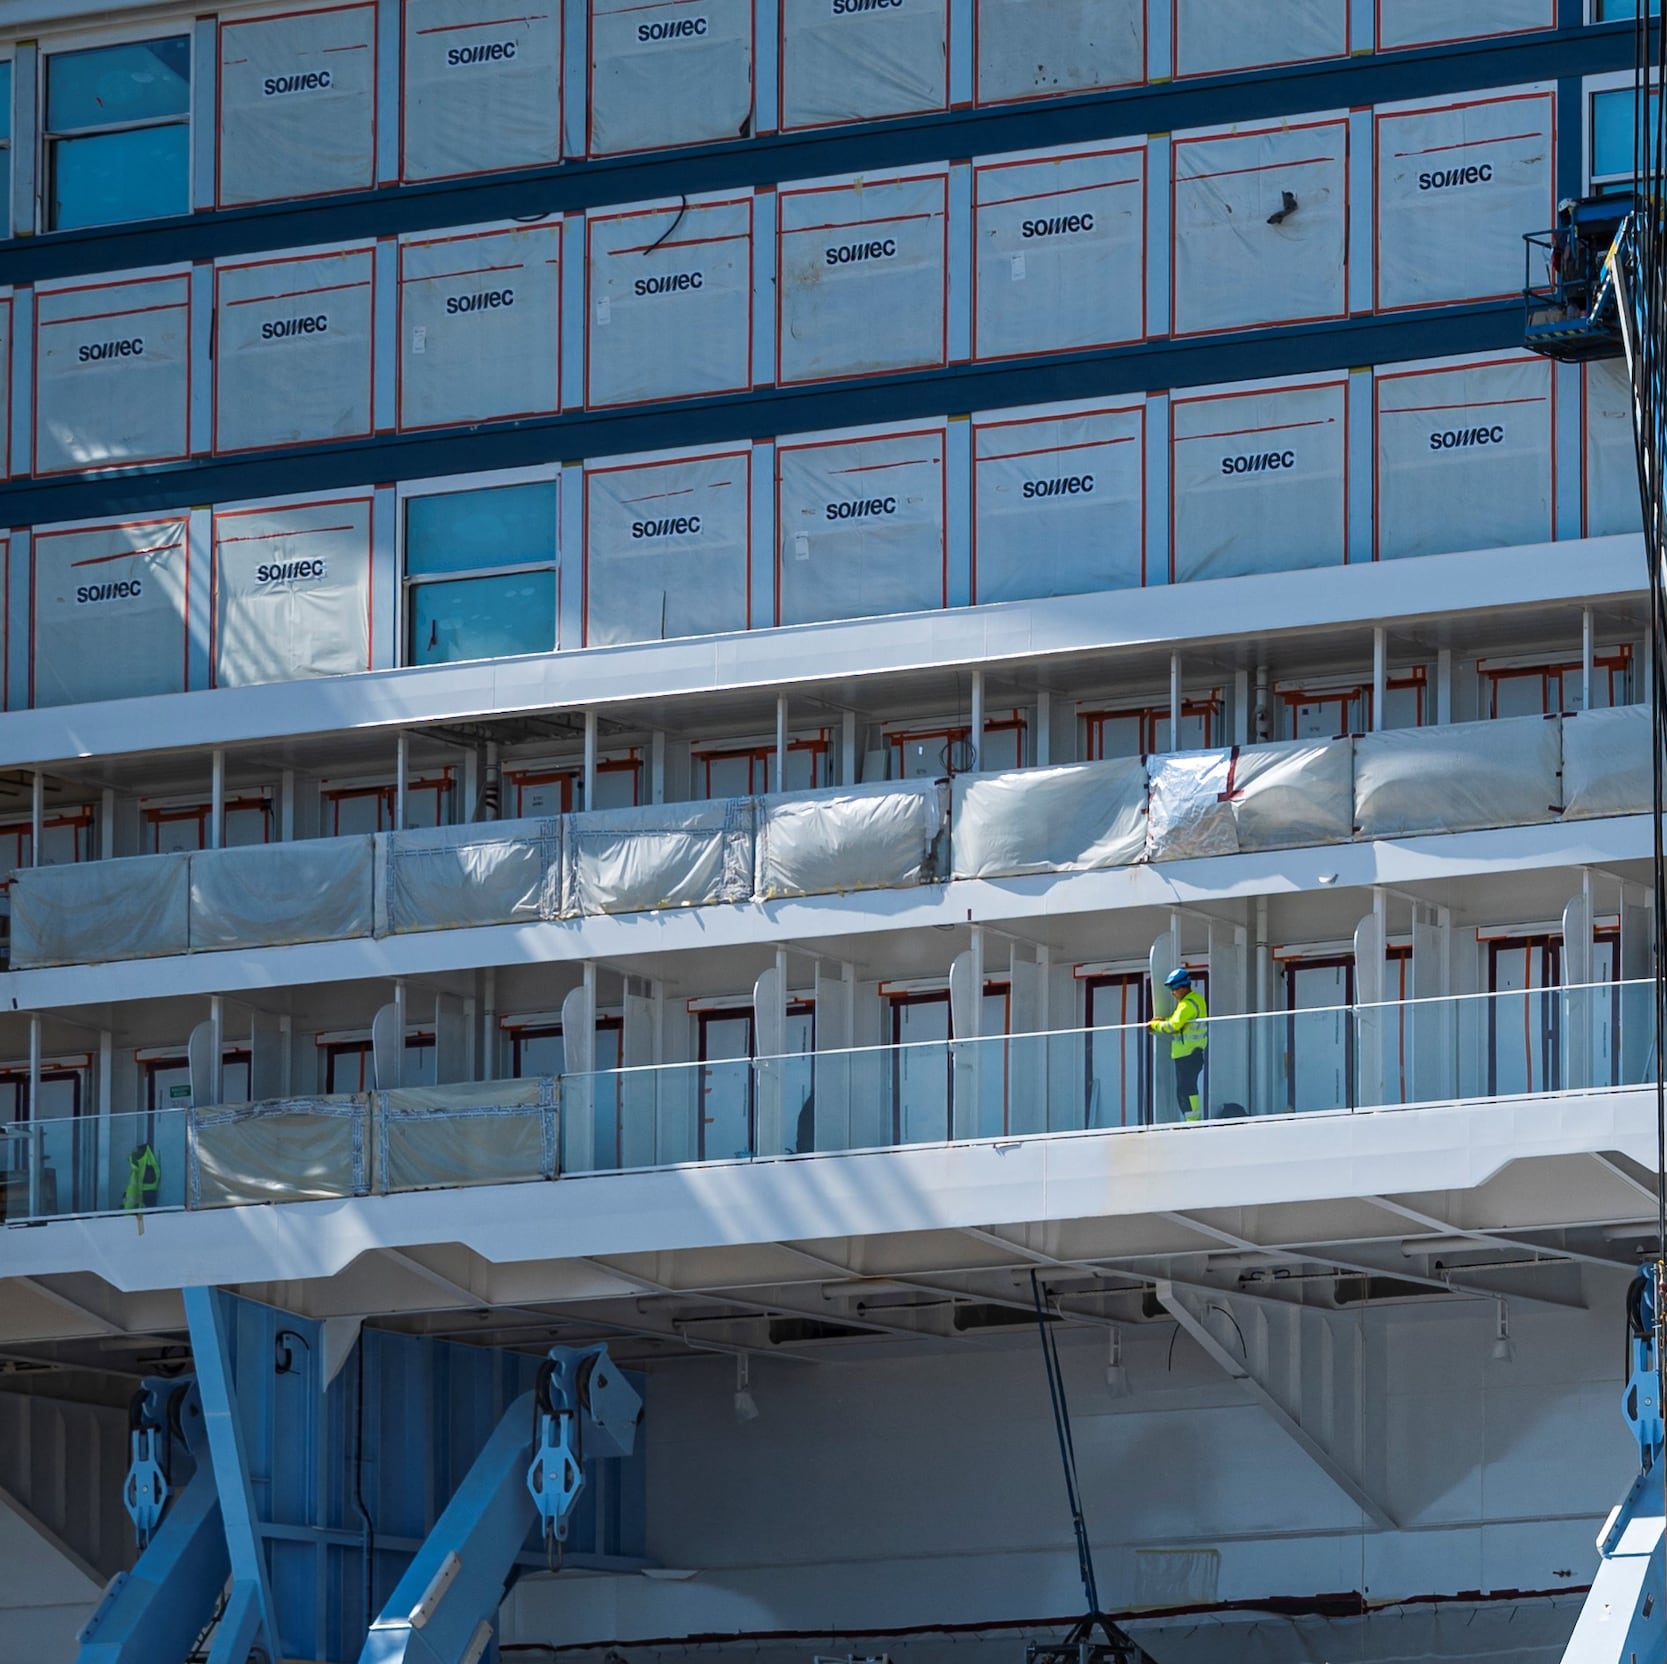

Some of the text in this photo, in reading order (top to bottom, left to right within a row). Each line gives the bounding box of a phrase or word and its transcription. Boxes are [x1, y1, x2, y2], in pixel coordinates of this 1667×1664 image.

[639, 19, 706, 41] somec
[448, 42, 515, 65] somec
[265, 72, 329, 95] somec
[1420, 165, 1491, 189] somec
[1023, 214, 1093, 237] somec
[826, 240, 895, 264] somec
[635, 273, 702, 295] somec
[447, 290, 513, 313] somec
[262, 316, 326, 339] somec
[79, 339, 143, 361] somec
[1431, 426, 1503, 449] somec
[1222, 451, 1293, 474] somec
[1024, 476, 1093, 497] somec
[827, 498, 895, 519] somec
[633, 517, 699, 538] somec
[258, 561, 322, 581] somec
[78, 581, 141, 603] somec
